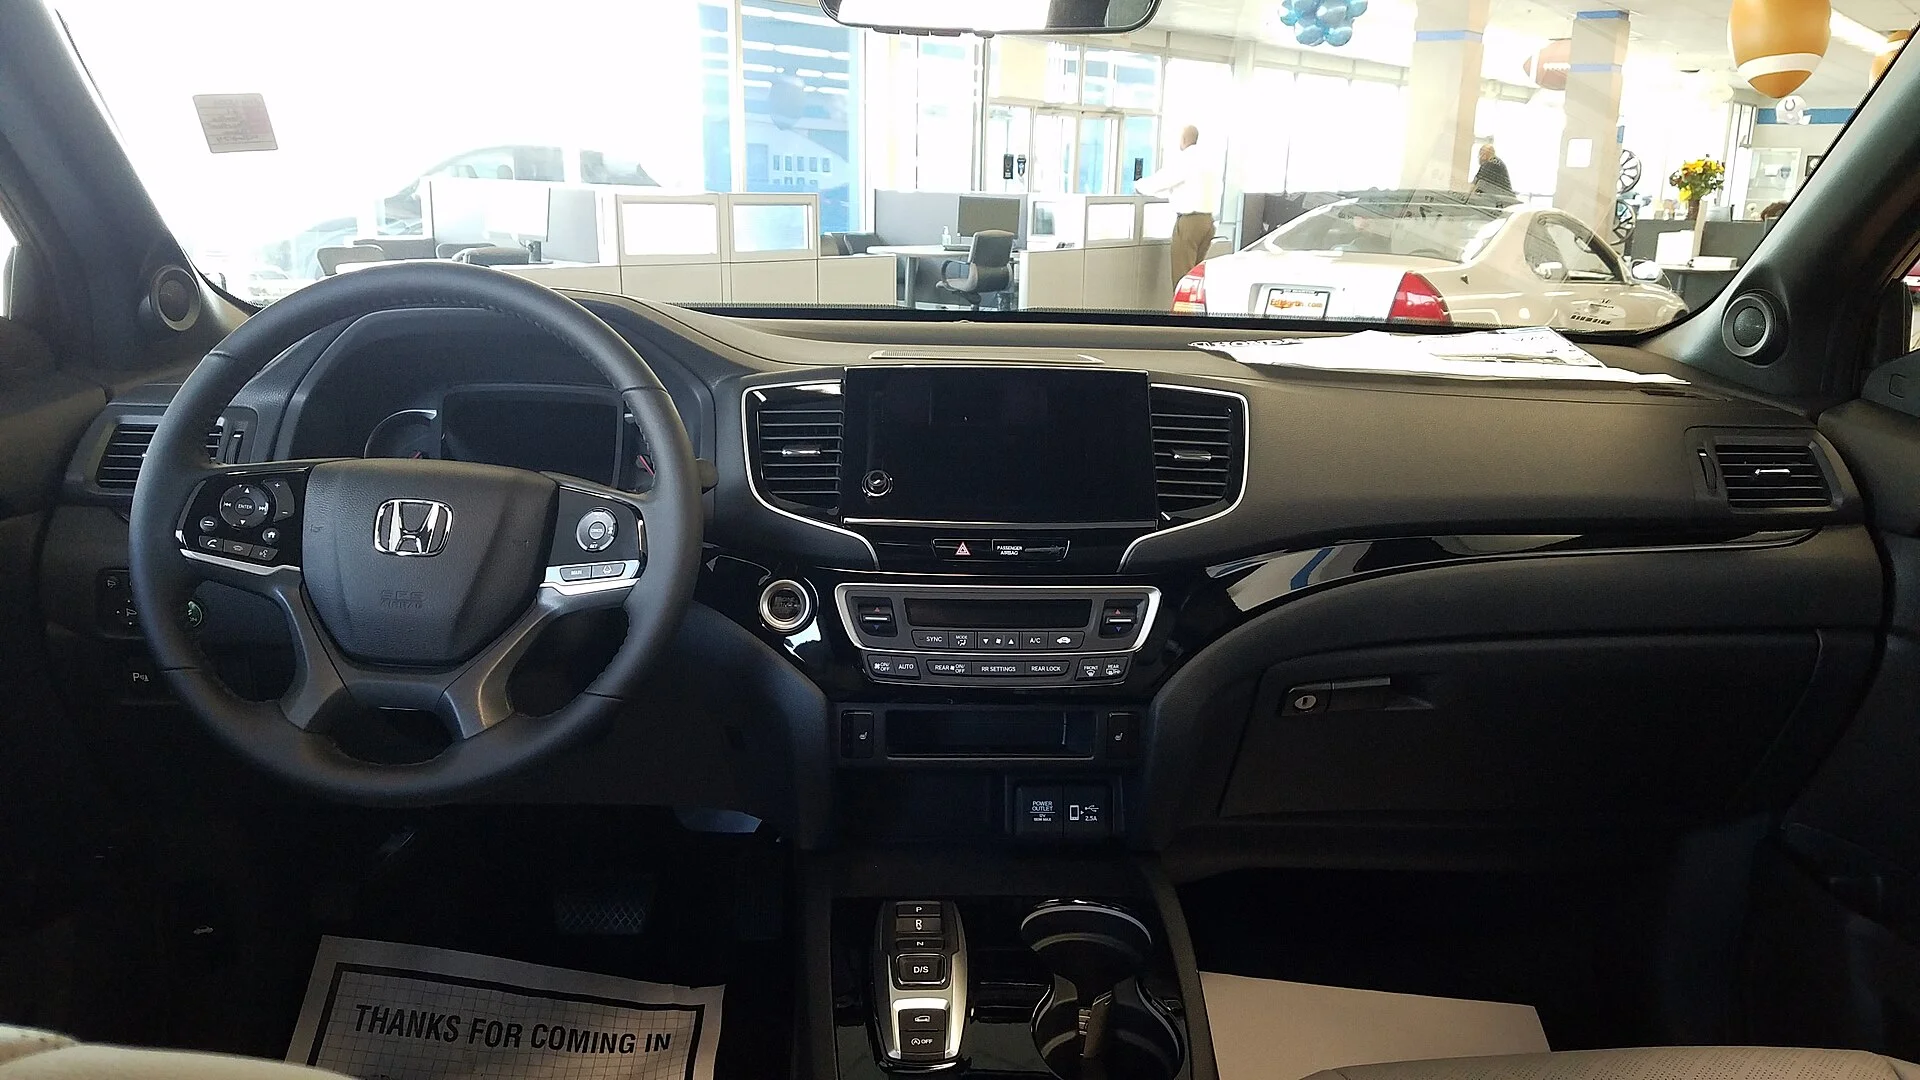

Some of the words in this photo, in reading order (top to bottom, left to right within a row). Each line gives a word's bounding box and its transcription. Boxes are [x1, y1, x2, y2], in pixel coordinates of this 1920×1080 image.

[915, 918, 923, 927] R
[913, 965, 929, 974] D/S
[354, 1003, 461, 1043] THANKS
[469, 1018, 522, 1049] FOR
[531, 1022, 636, 1054] COMING
[644, 1032, 671, 1053] IN
